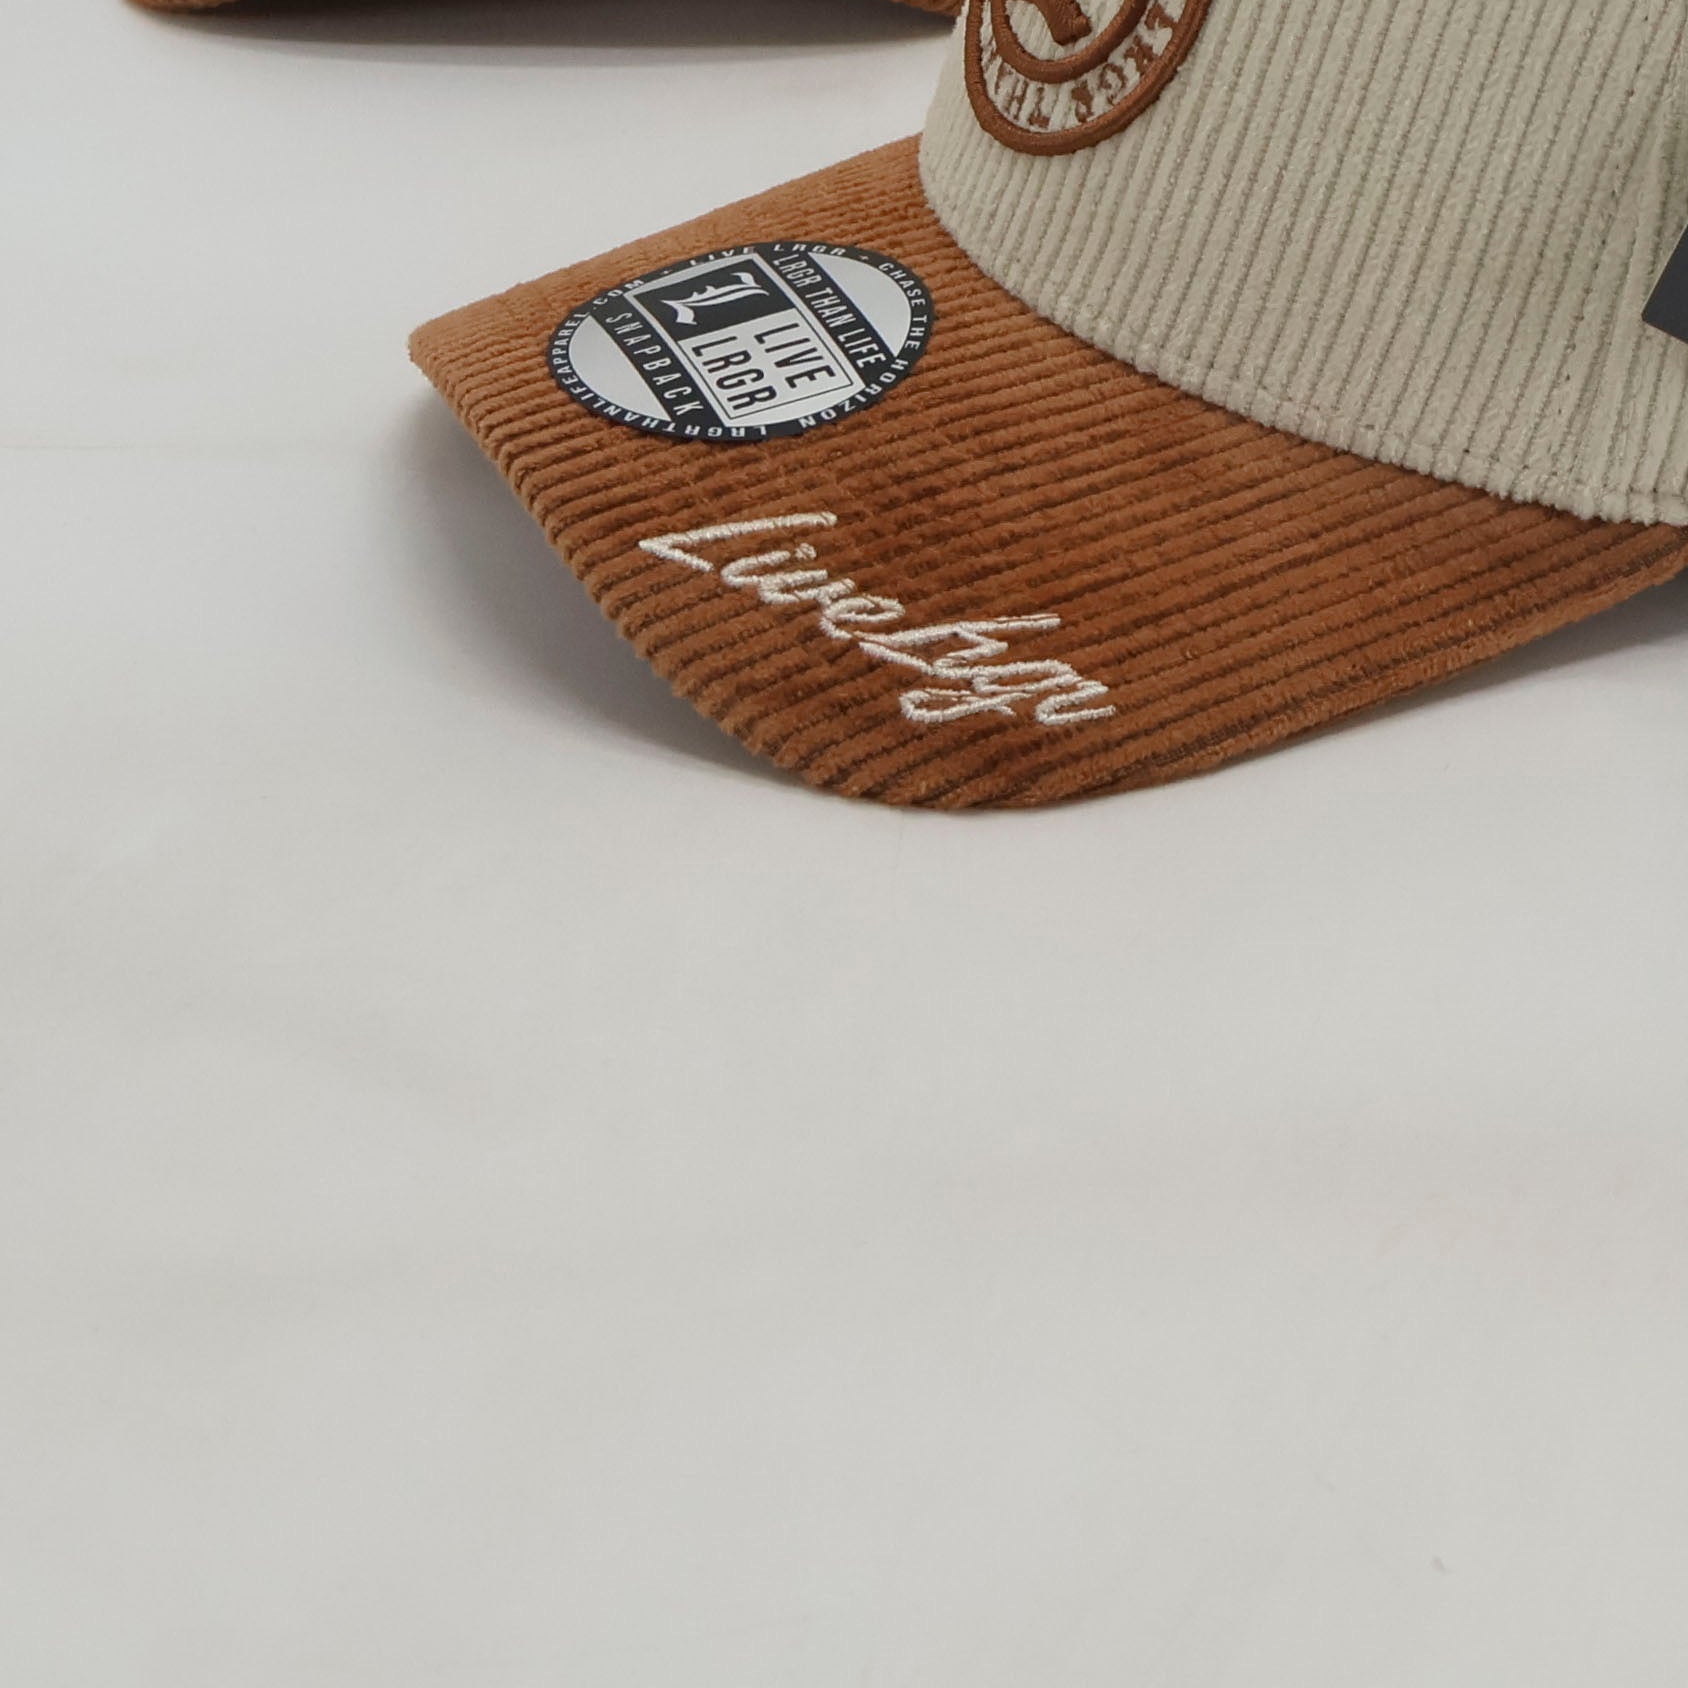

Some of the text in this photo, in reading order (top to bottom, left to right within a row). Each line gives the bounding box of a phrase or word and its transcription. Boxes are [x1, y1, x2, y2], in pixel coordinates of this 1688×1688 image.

[773, 254, 886, 368] LRGR THAN LIFE
[878, 262, 926, 307] CHASE
[605, 312, 704, 416] SNAPBACK
[754, 322, 836, 389] LIVE
[904, 315, 927, 350] THE
[692, 335, 777, 411] LRGR
[798, 359, 909, 428] HORIZON
